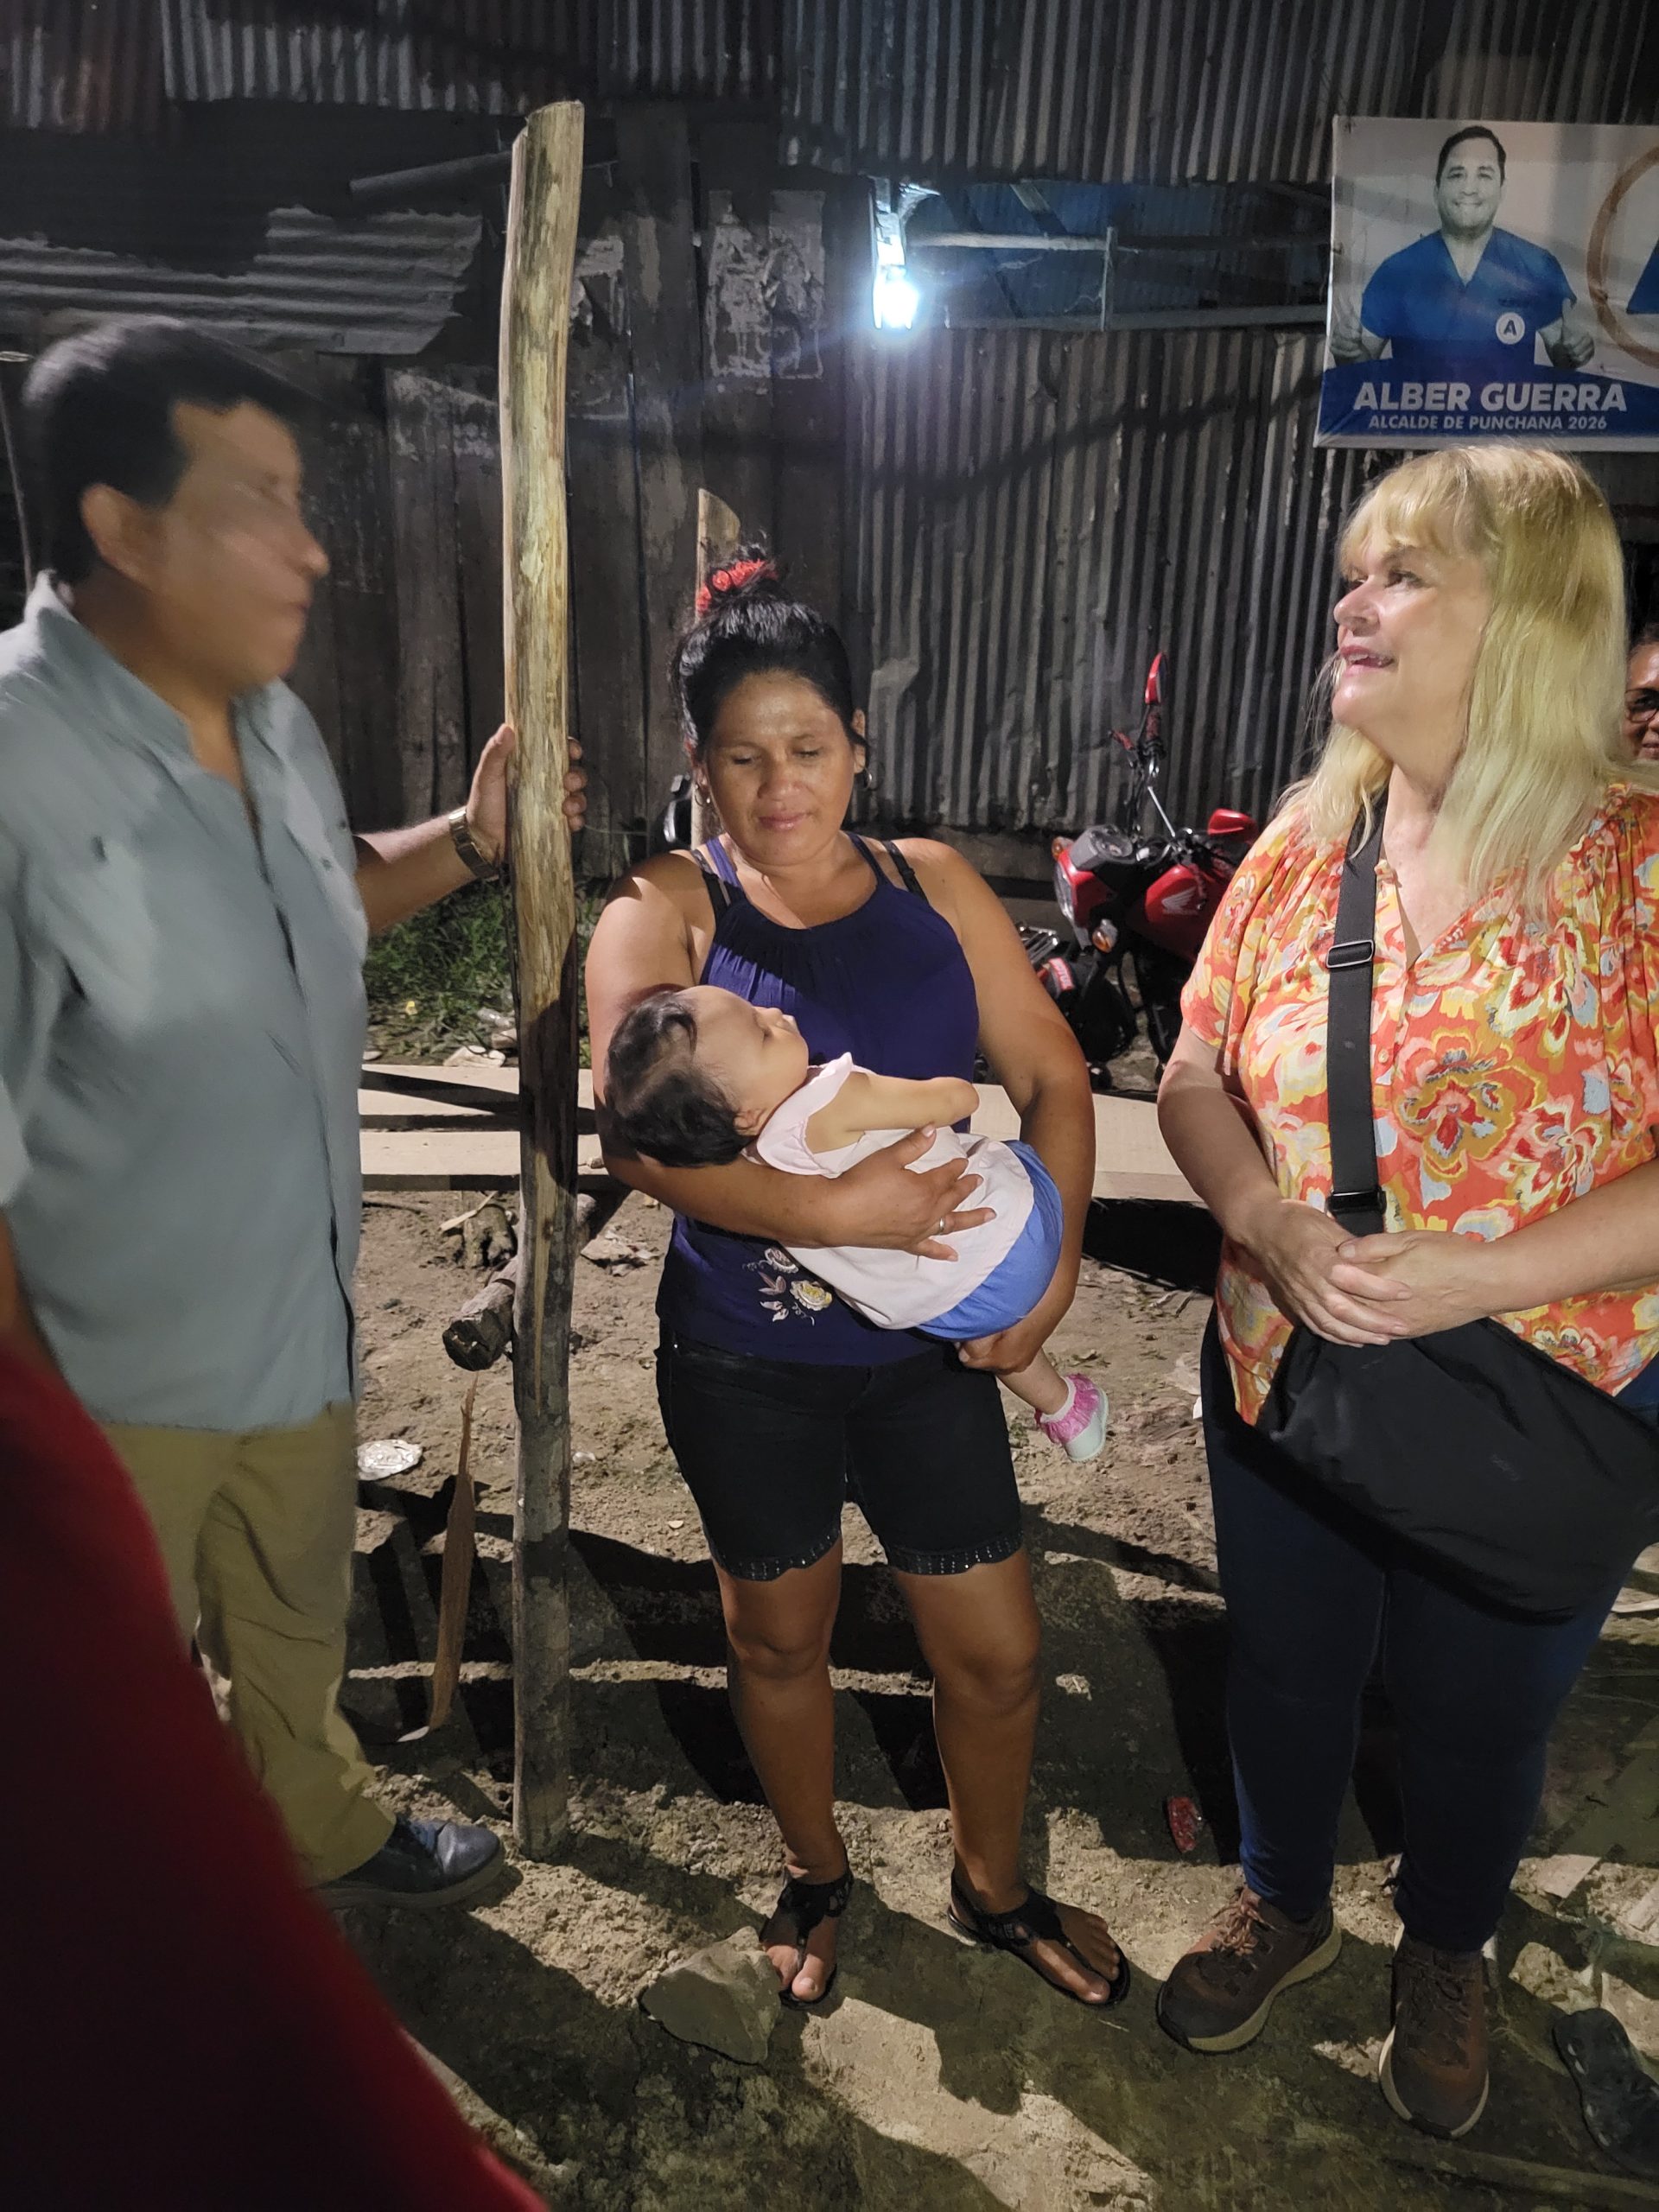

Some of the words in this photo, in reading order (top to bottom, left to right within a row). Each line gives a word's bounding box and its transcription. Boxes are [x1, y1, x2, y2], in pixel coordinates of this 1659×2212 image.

[1503, 319, 1517, 336] A
[1353, 382, 1471, 411] ALBER
[1480, 382, 1627, 412] GUERRA
[1369, 415, 1438, 429] ALCALDE
[1443, 416, 1465, 429] DE
[1469, 416, 1562, 429] PUNCHANA
[1567, 416, 1607, 429] 2026
